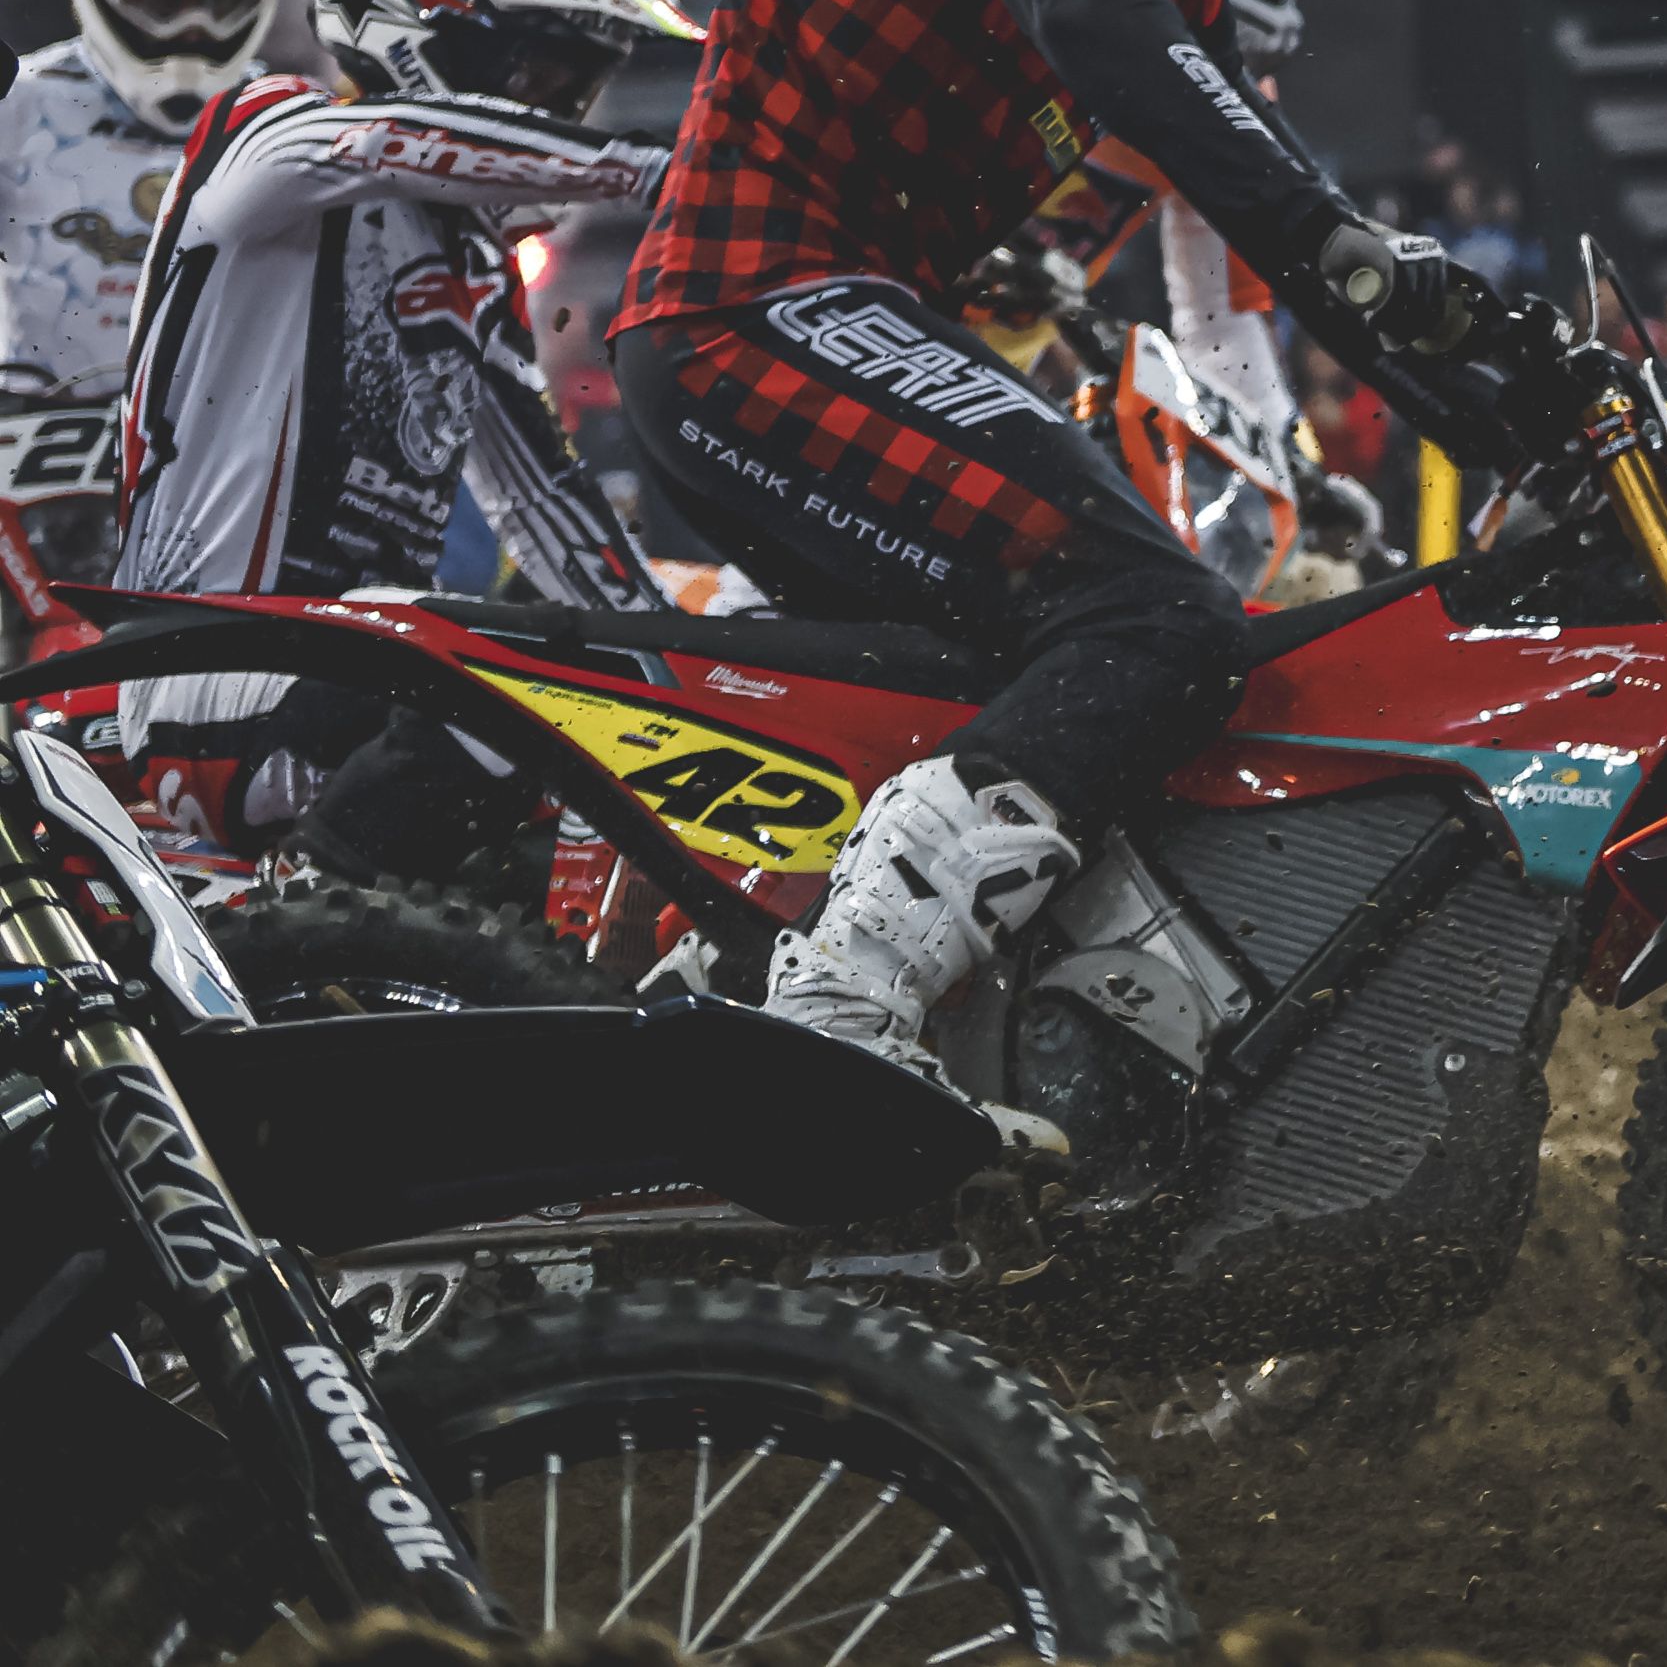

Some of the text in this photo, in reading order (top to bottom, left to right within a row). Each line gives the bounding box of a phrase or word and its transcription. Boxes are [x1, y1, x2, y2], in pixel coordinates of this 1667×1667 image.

[676, 418, 955, 582] STARK FUTURE
[284, 1344, 456, 1572] ROCK OIL
